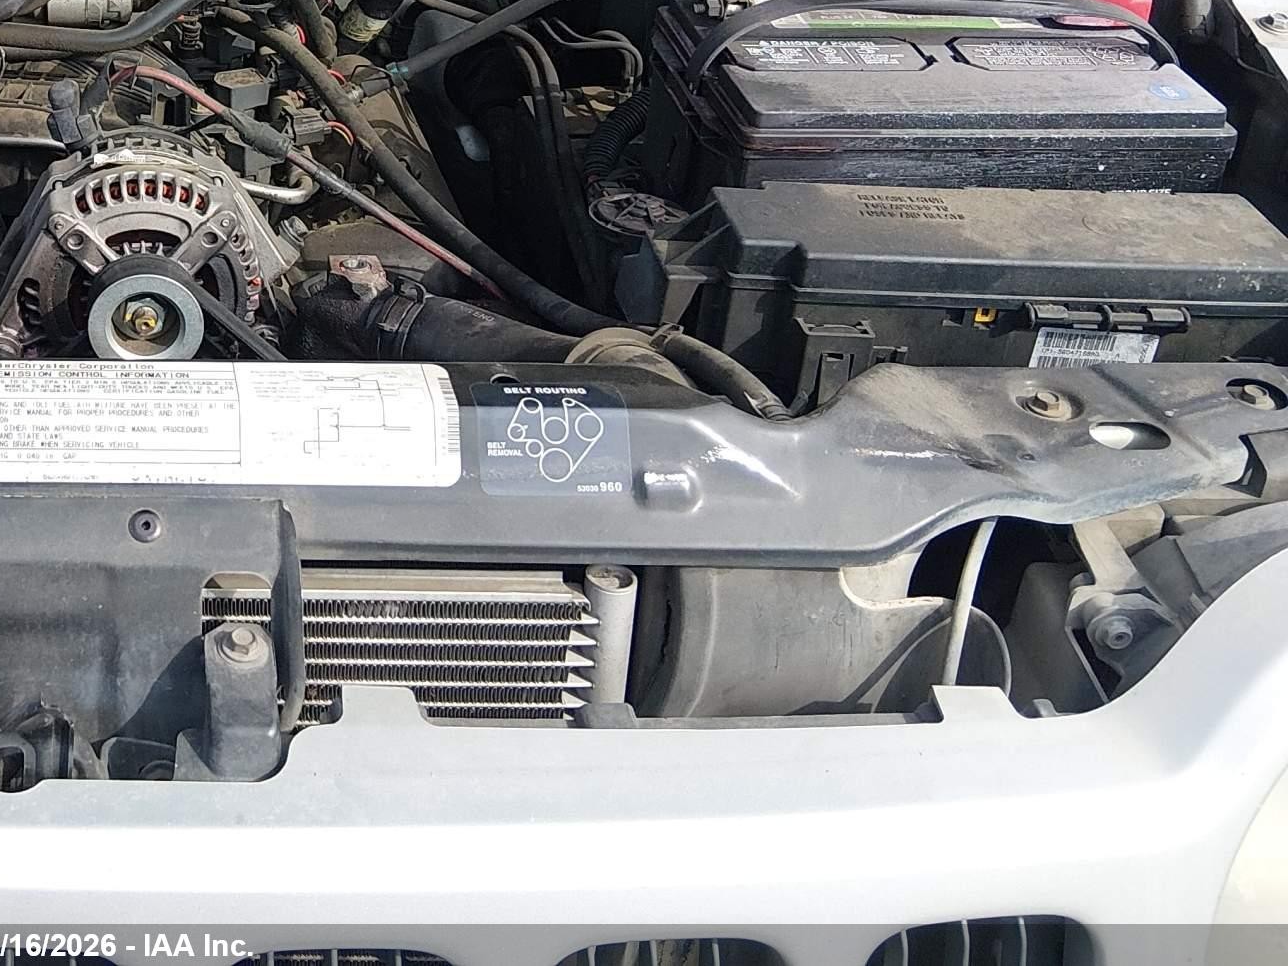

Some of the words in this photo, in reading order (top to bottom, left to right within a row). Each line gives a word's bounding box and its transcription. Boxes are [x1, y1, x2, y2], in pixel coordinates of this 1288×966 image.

[79, 363, 155, 372] Corporation
[503, 387, 532, 395] BELT
[535, 387, 587, 395] ROUTING
[487, 448, 523, 457] REMOVAL
